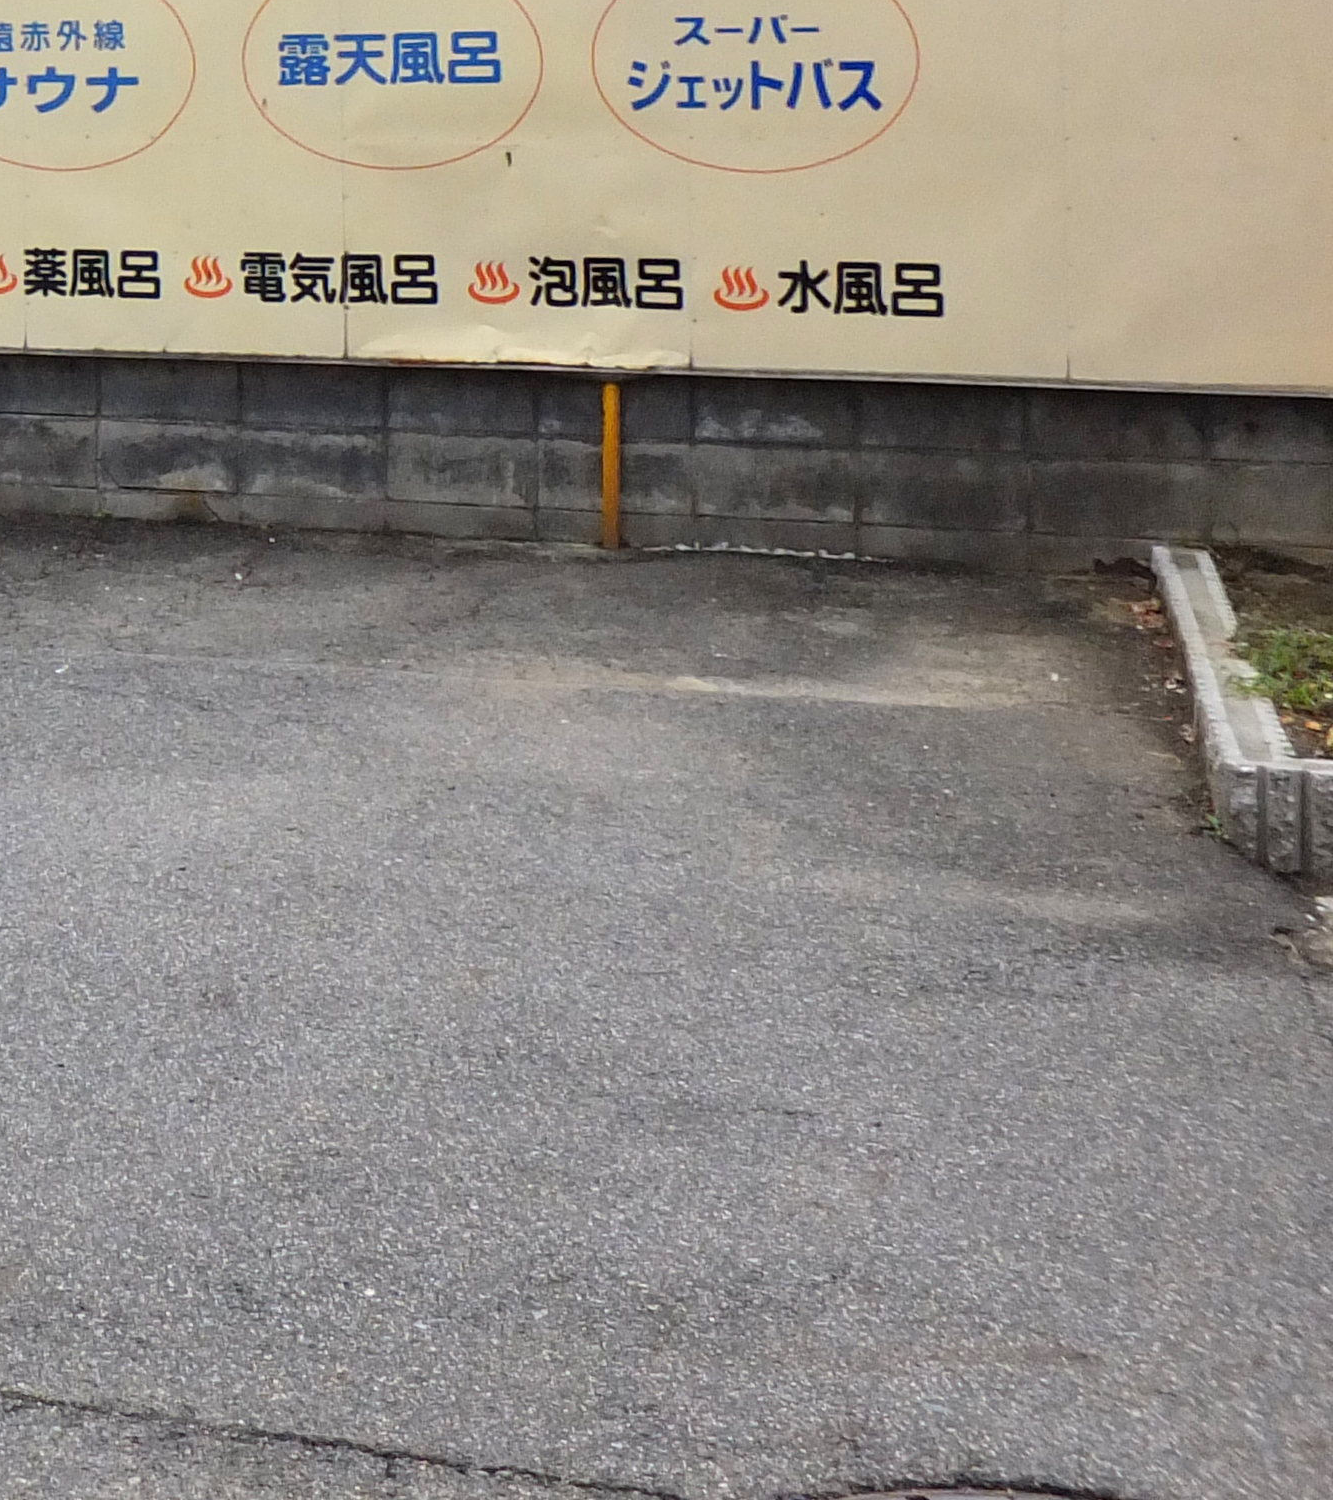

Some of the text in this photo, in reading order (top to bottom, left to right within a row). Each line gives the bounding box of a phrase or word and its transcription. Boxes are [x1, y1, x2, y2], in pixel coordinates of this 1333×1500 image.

[674, 14, 820, 46] スーパー
[278, 31, 502, 86] 露天風呂
[627, 57, 883, 112] ジェットバス
[23, 247, 161, 299] 薬風呂
[240, 251, 439, 305] 電気風呂
[528, 256, 684, 310] 泡風呂
[777, 259, 945, 318] 水風呂
